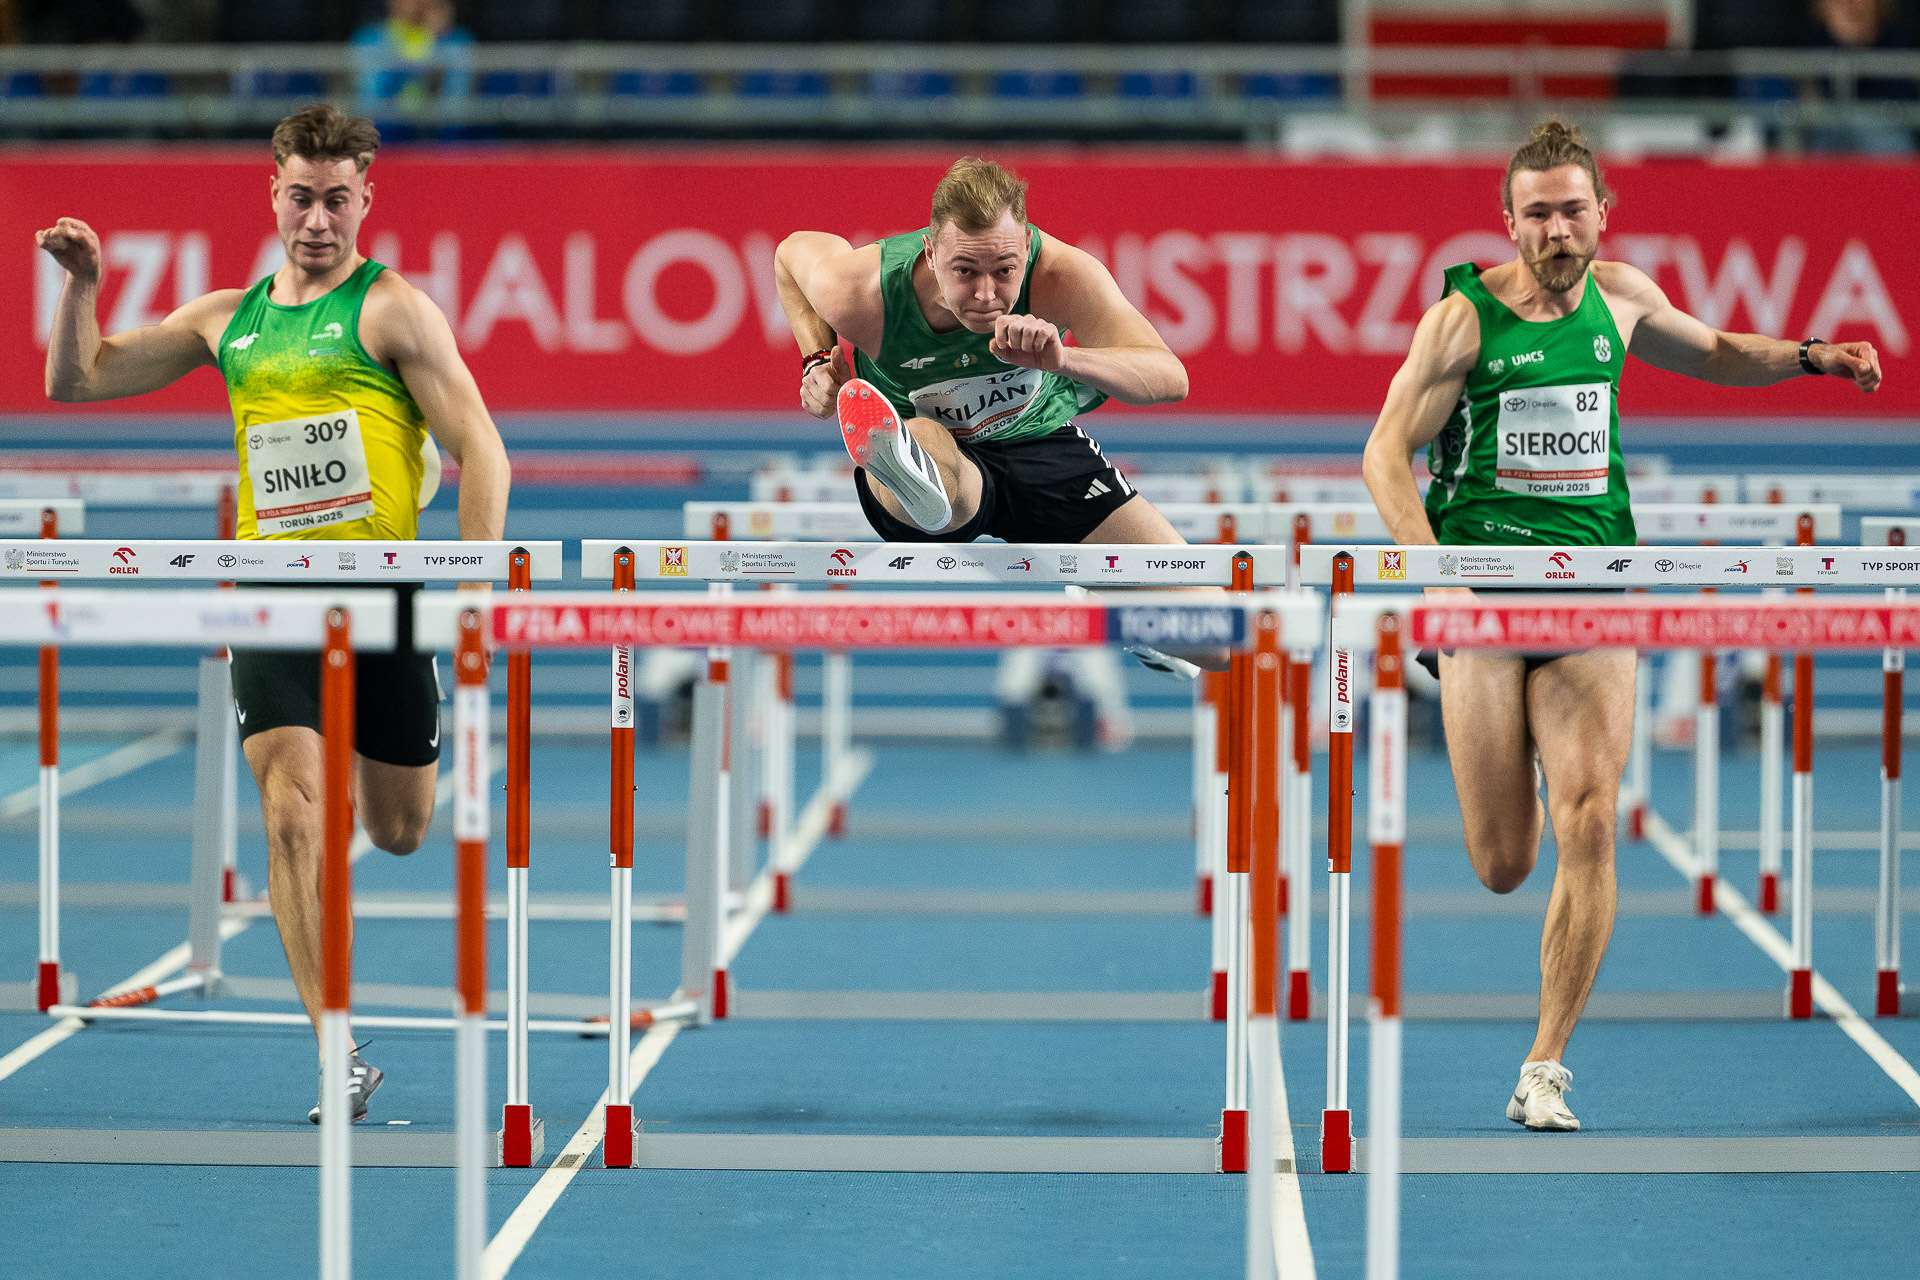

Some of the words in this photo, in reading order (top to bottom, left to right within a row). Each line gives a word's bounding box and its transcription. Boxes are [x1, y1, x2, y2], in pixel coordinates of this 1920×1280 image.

[899, 356, 936, 370] 4F
[1511, 350, 1545, 366] UMCS
[934, 384, 1027, 422] KILJAN
[1576, 391, 1598, 412] 82
[303, 419, 348, 445] 309
[1505, 429, 1606, 456] SIEROCKI
[264, 460, 346, 494] SINIŁO
[1527, 482, 1563, 493] TORUŃ
[1566, 483, 1590, 492] 2025
[280, 514, 315, 529] TORUŃ
[317, 510, 344, 523] 2025
[169, 554, 196, 568] 4F
[424, 556, 446, 566] TVP
[448, 556, 484, 566] SPORT
[741, 552, 783, 560] Ministerstwo
[26, 558, 48, 566] Sportu
[51, 558, 80, 566] Turystyki
[241, 558, 265, 566] Okęcie
[741, 560, 764, 568] Sportu
[767, 560, 797, 568] Turystyki
[888, 556, 914, 570] 4F
[961, 560, 985, 568] Okęcie
[1146, 560, 1169, 570] TVP
[1170, 560, 1206, 570] SPORT
[1606, 559, 1633, 573] 4F
[1678, 562, 1702, 571] Okęcie
[1861, 562, 1884, 571] TVP
[1886, 562, 1920, 571] SPORT
[109, 566, 139, 574] ORLEN
[660, 566, 686, 576] PZLA
[826, 568, 857, 577] ORLEN
[1460, 563, 1482, 572] Sportu
[1486, 563, 1515, 572] Turystyki
[1378, 570, 1406, 579] PZLA
[1544, 571, 1576, 580] ORLEN
[615, 642, 631, 699] polanik
[1334, 646, 1350, 704] polanik
